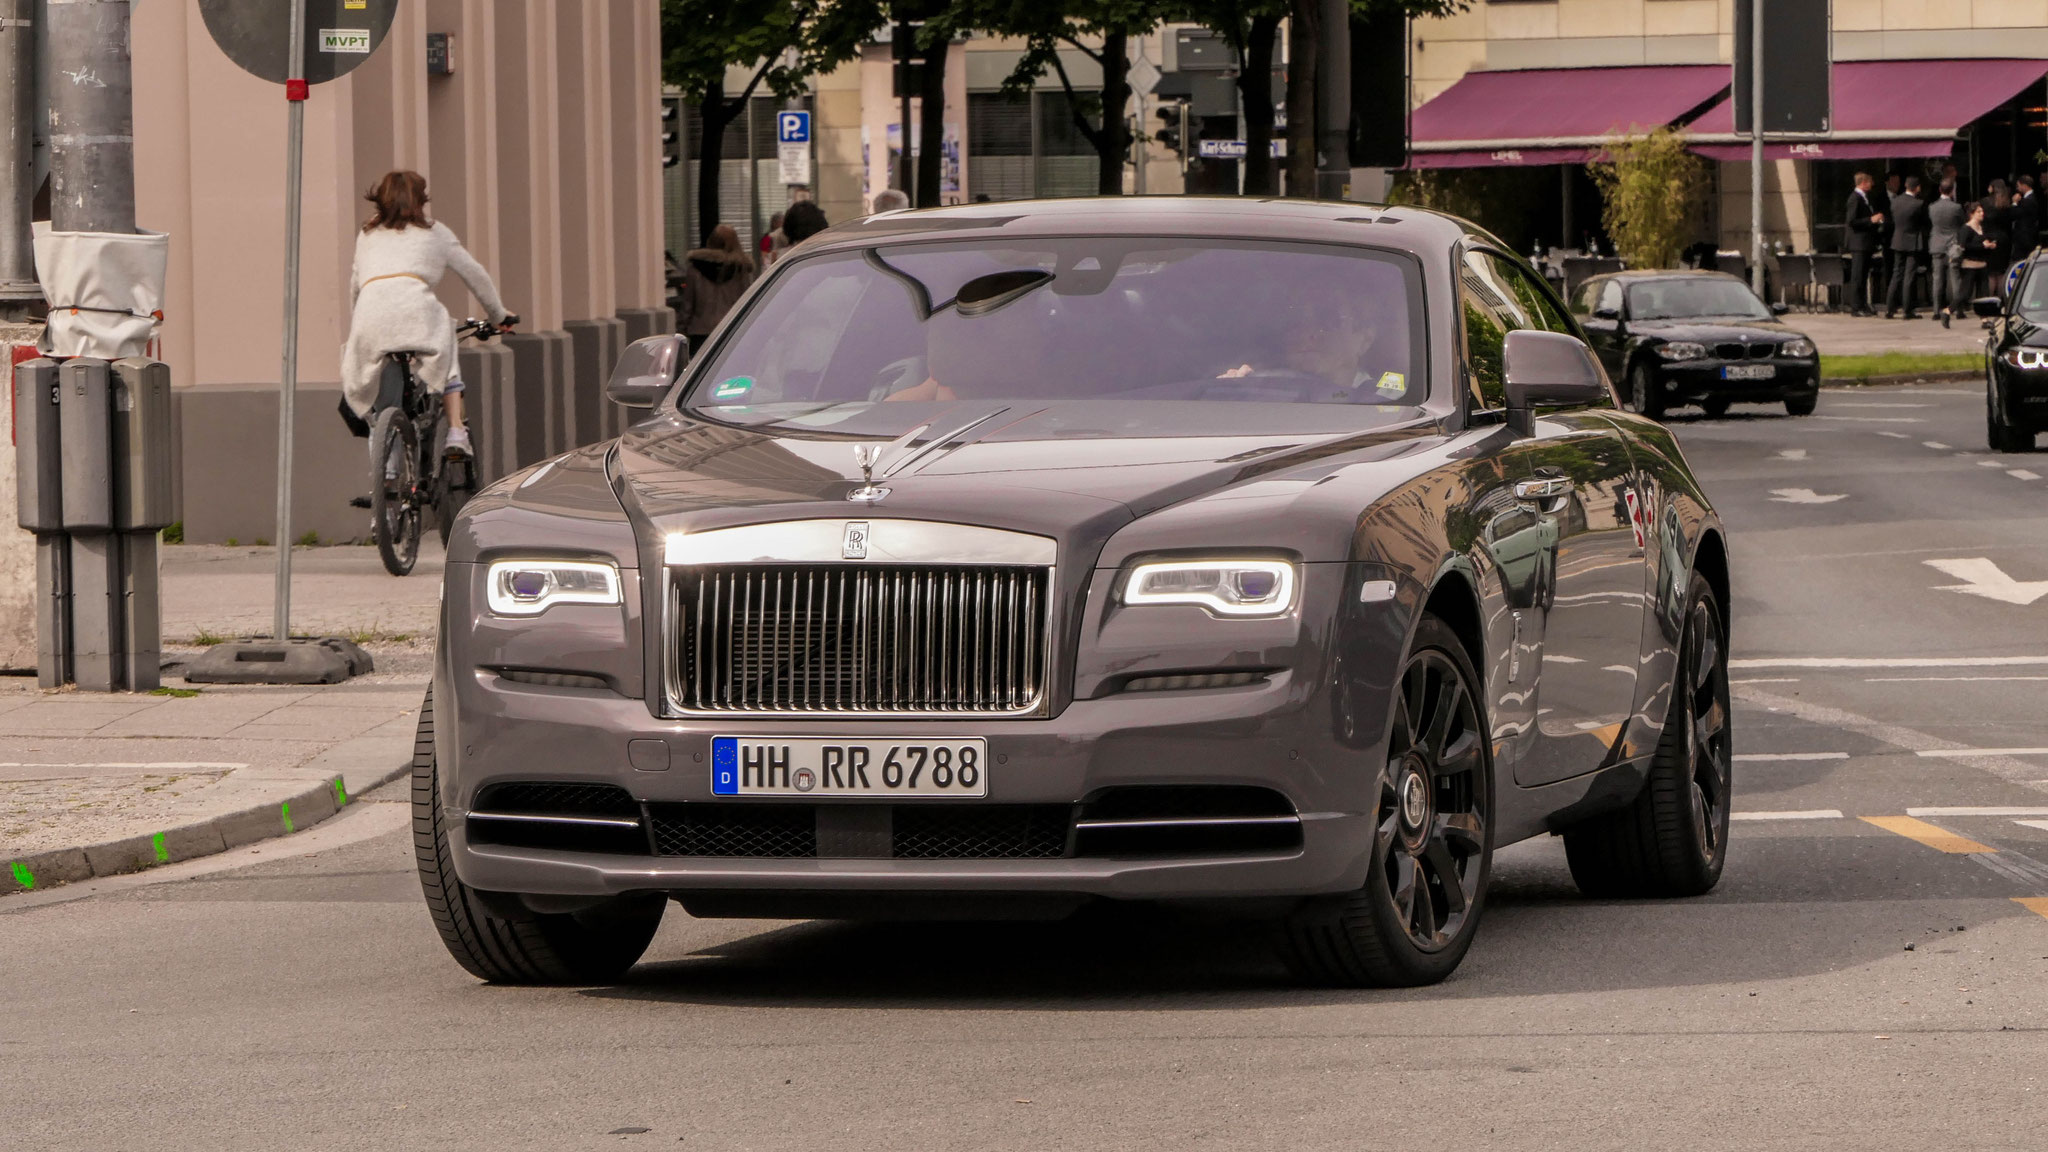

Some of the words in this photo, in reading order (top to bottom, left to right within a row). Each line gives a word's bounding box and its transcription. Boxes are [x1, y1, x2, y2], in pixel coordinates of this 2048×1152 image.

[325, 36, 368, 47] MVPT
[782, 115, 801, 140] P
[741, 745, 790, 788] HH
[821, 745, 871, 789] RR
[881, 745, 979, 789] 6788
[721, 771, 731, 784] D
